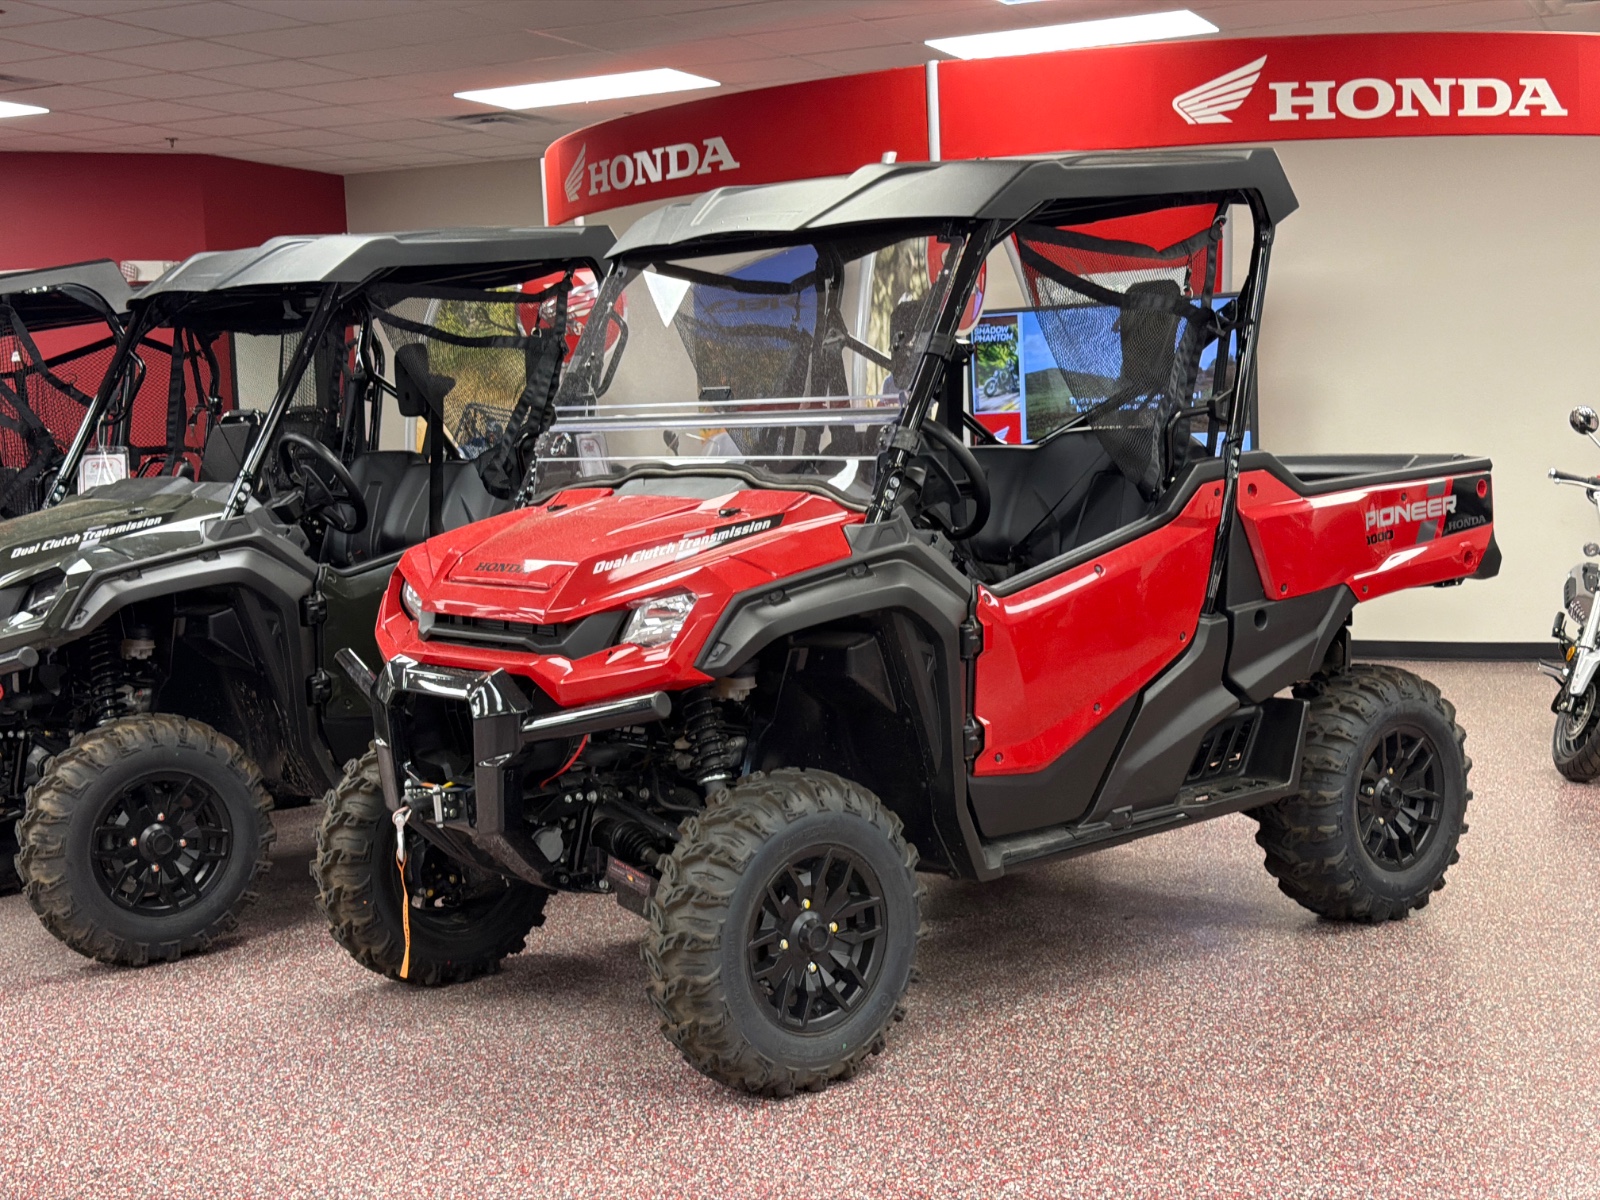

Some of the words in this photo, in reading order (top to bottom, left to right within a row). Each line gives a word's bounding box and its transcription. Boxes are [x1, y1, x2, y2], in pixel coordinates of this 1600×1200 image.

[1269, 77, 1568, 121] HONDA
[588, 136, 740, 196] HONDA
[974, 325, 1009, 335] SHADOW
[974, 332, 1013, 343] PHANTOM
[1365, 494, 1457, 531] PIONEER
[1447, 515, 1486, 531] HONDA
[11, 543, 39, 559] Dual
[41, 533, 81, 551] Clutch
[82, 516, 163, 541] Transmission
[592, 553, 627, 574] Dual
[629, 541, 676, 564] Clutch
[677, 519, 771, 550] Transmission
[1366, 529, 1394, 545] 1000
